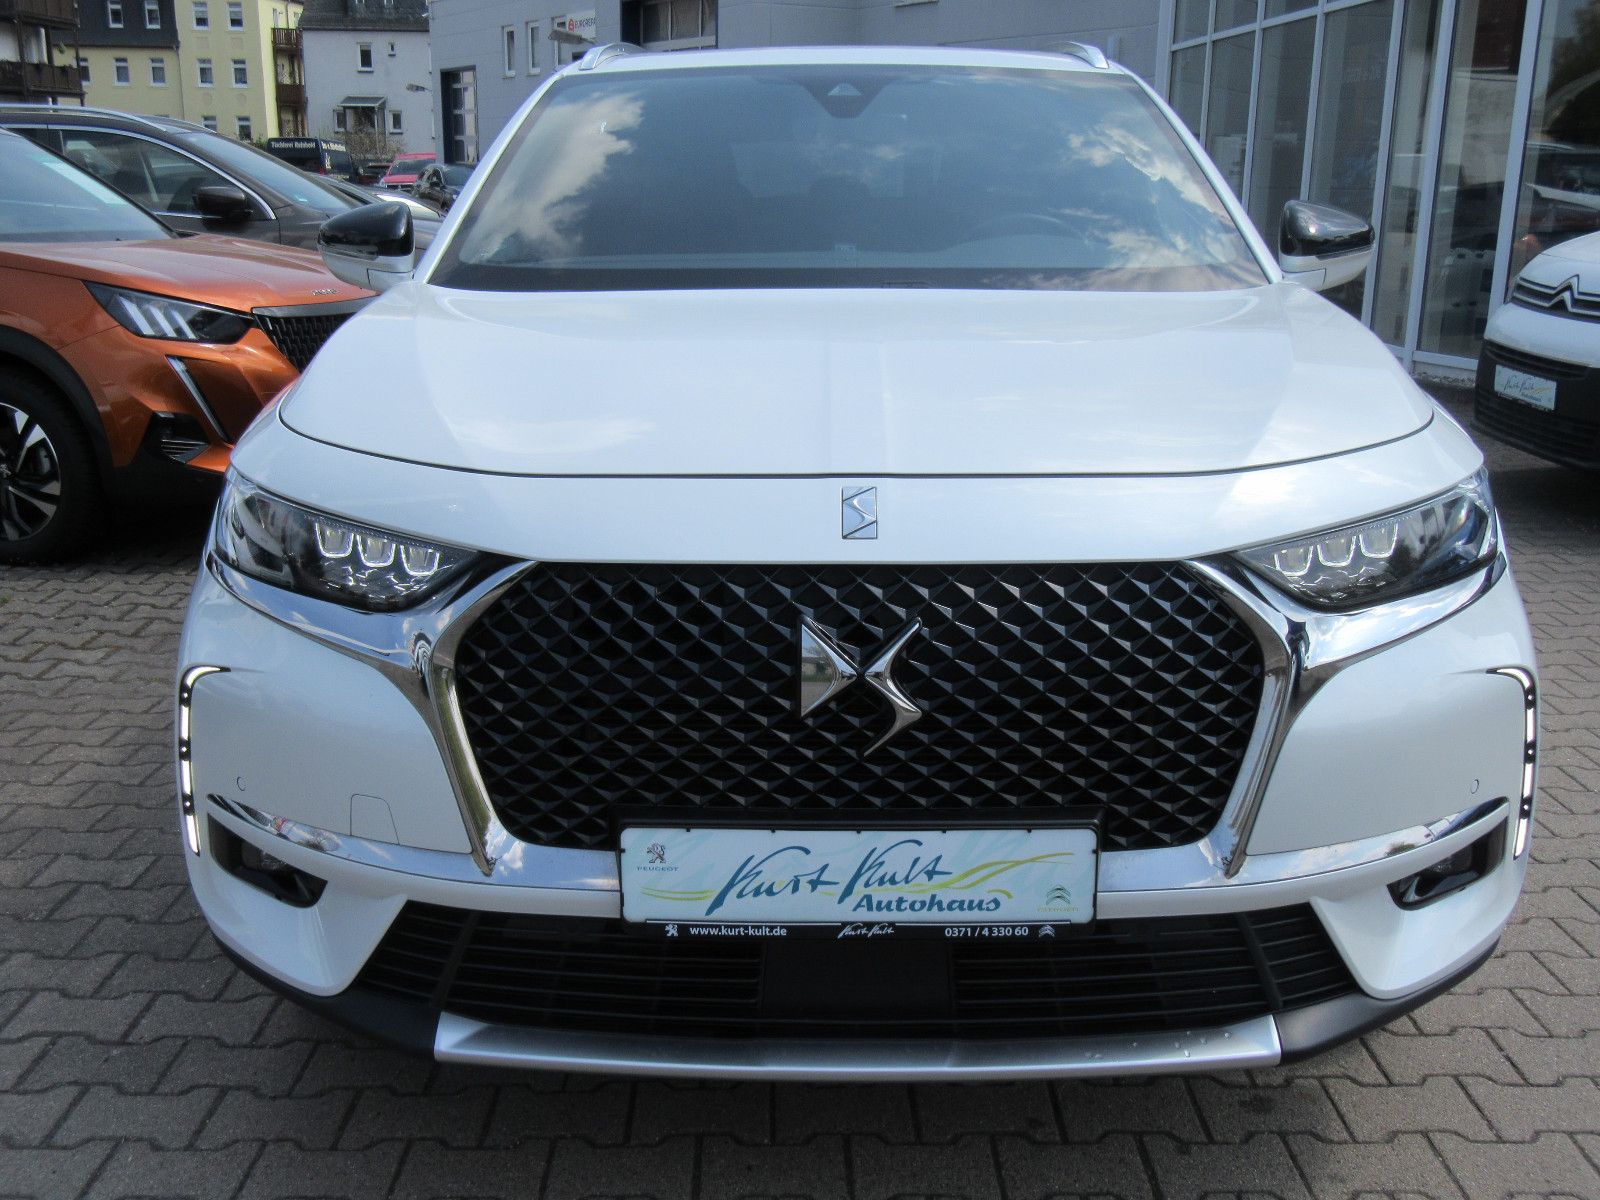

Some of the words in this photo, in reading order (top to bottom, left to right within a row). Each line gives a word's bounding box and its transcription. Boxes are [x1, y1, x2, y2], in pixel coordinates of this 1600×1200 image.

[705, 846, 839, 916] Kurt
[838, 839, 953, 904] Kult
[852, 893, 1001, 912] Autohaus
[690, 925, 787, 937] www.kurt-kult.de
[945, 927, 971, 937] 0371
[982, 927, 989, 937] 4
[991, 927, 1012, 936] 330
[1014, 926, 1029, 936] 60
